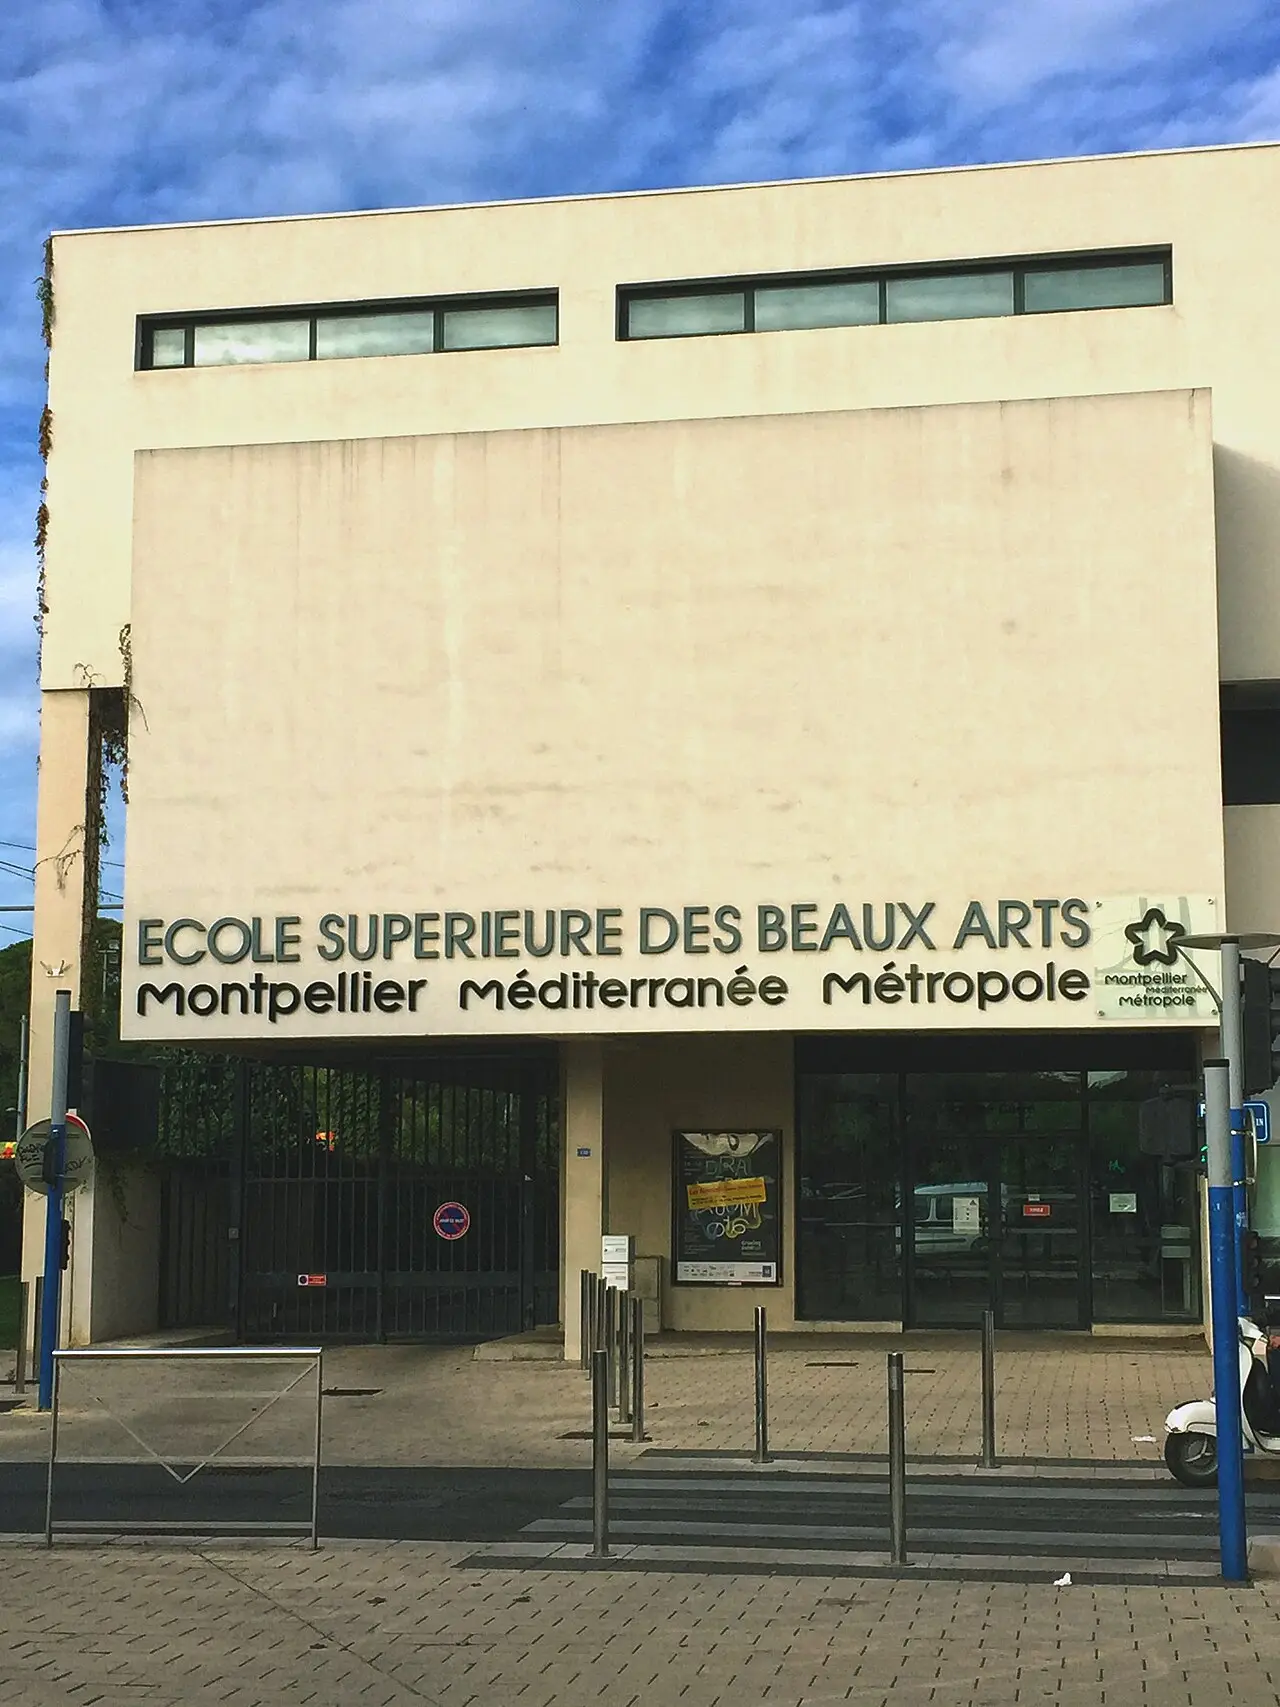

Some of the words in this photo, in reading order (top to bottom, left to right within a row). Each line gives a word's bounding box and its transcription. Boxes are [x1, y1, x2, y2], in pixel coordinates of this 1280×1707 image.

[138, 916, 302, 966] ECOLE
[316, 907, 623, 962] SUPERIEURE
[640, 904, 742, 955] DES
[757, 901, 937, 953] BEAUX
[952, 898, 1092, 951] ARTS
